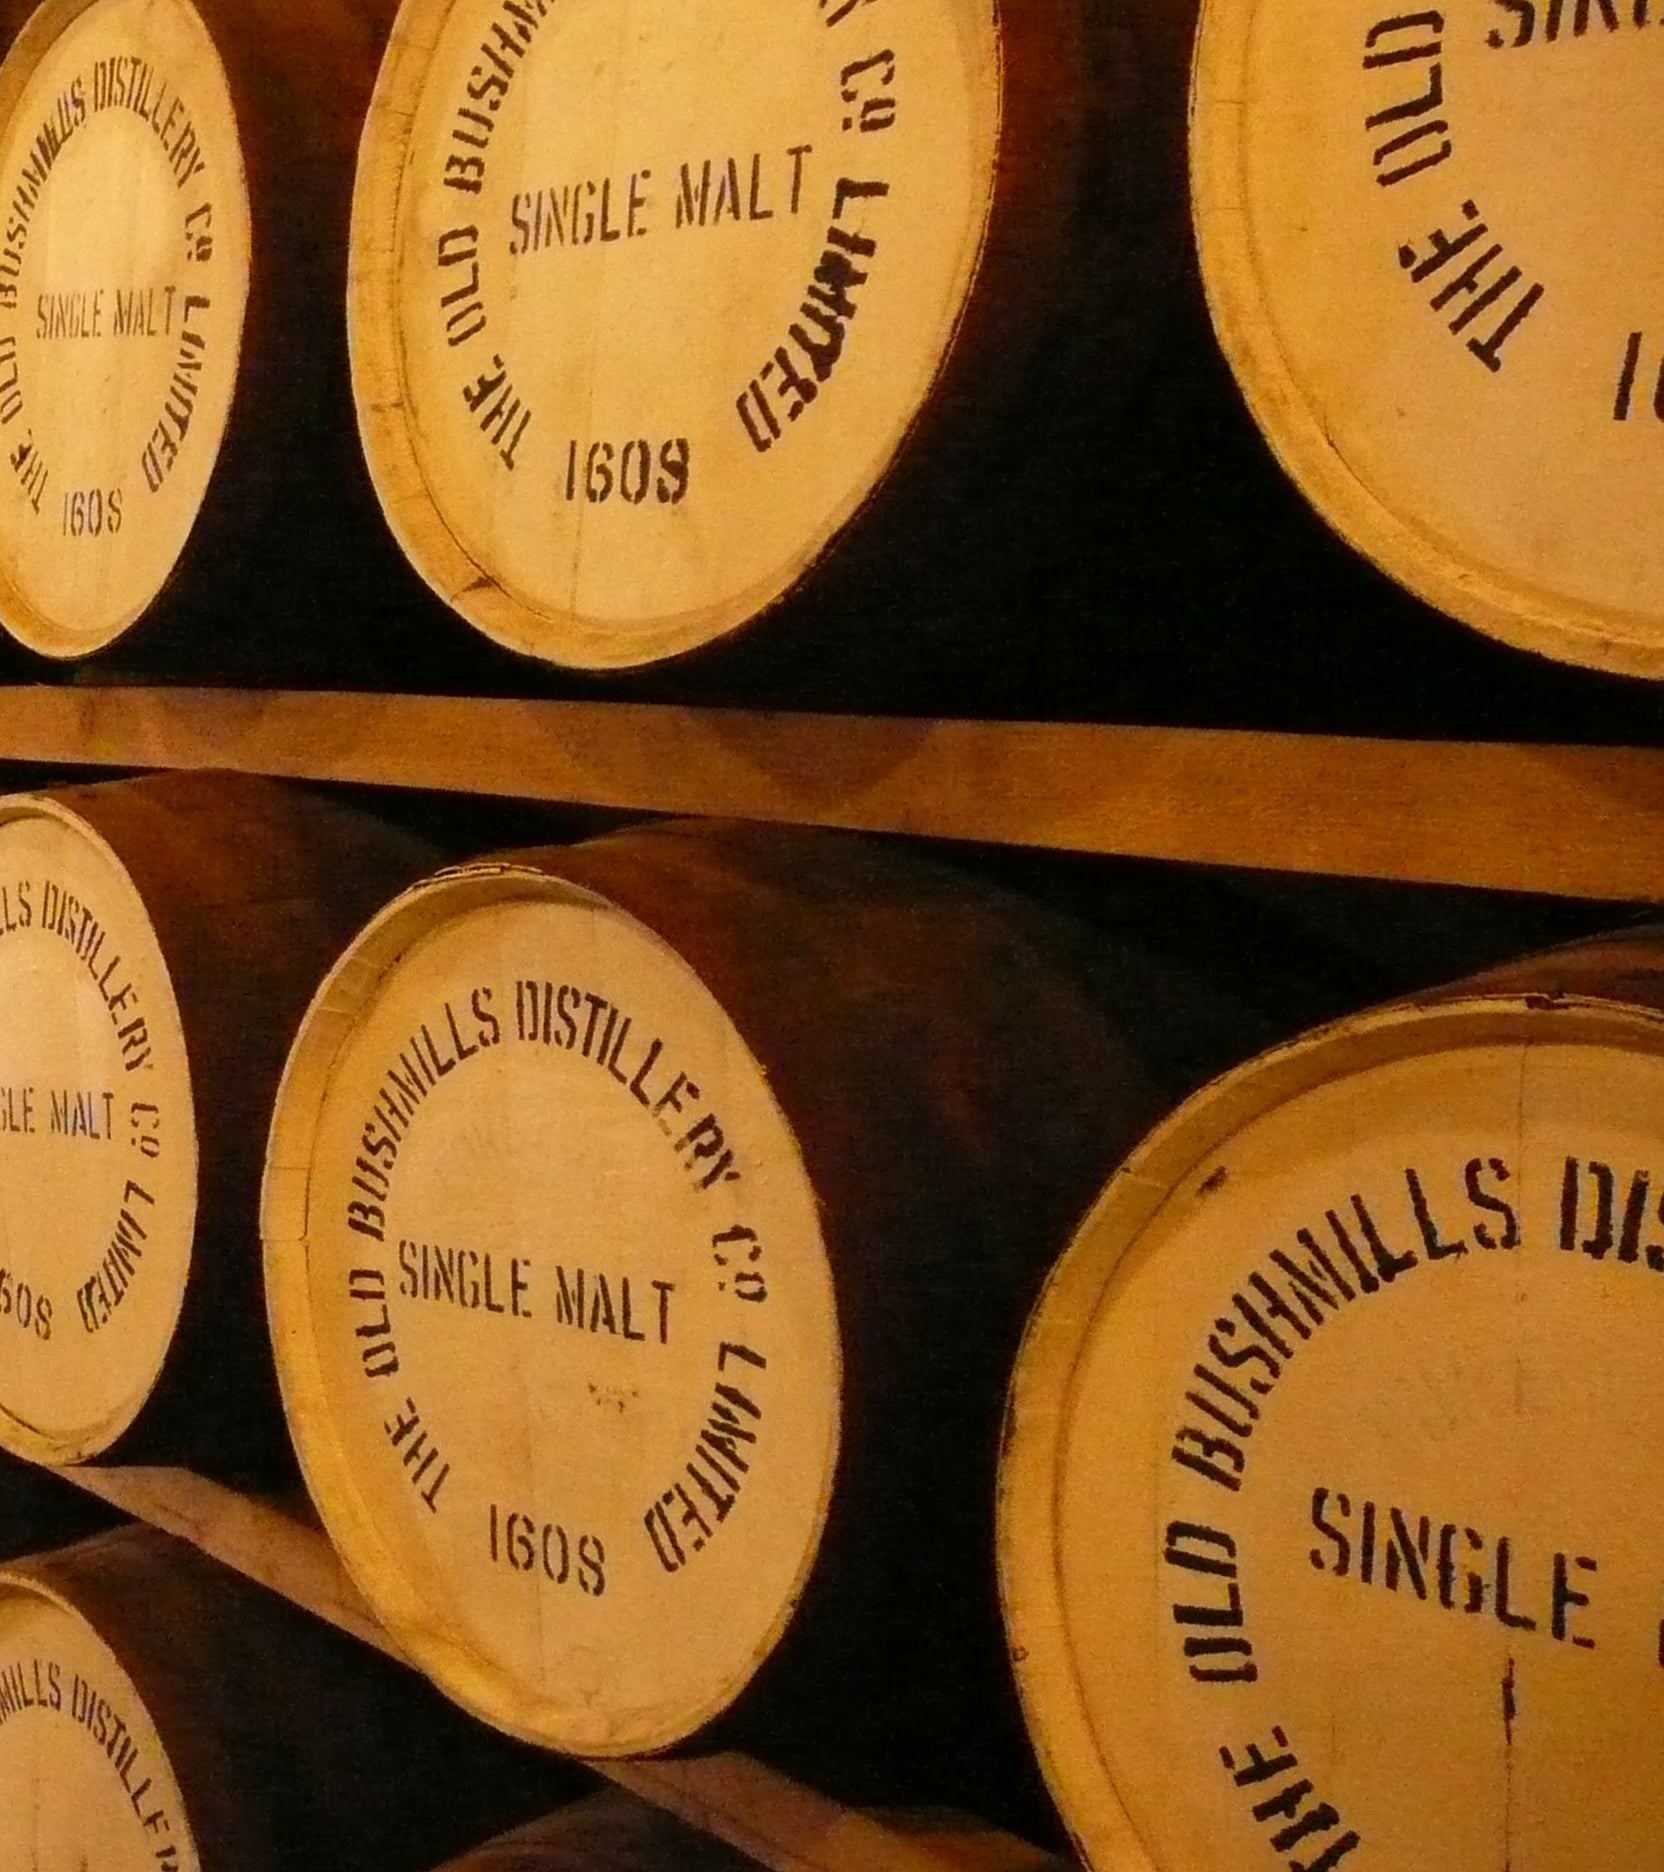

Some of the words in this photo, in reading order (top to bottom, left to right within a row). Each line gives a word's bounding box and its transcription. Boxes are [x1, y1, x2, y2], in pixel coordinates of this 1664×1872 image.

[1362, 10, 1452, 187] OLD
[509, 170, 651, 254] SINGLE
[676, 144, 812, 228] MALT
[36, 290, 103, 339] SINGLE
[113, 285, 176, 336] MALT
[438, 224, 486, 346] OLD
[1398, 200, 1544, 372] THE
[10, 429, 50, 515] THE
[462, 355, 531, 470] THE
[566, 437, 689, 503] 1608
[62, 487, 123, 537] 1608
[41, 880, 153, 1072] DISTILLERY
[50, 1090, 114, 1140] MALT
[348, 984, 500, 1243] BUSHMILLS
[515, 980, 741, 1193] DISTILLERY
[77, 1179, 154, 1334] LIMITED
[398, 1240, 531, 1319] SINGLE
[556, 1265, 675, 1344] MALT
[348, 1269, 400, 1378] OLD
[1172, 1157, 1520, 1491] BUSHMILLS
[383, 1397, 450, 1513] THE
[643, 1341, 768, 1572] LIMITED
[489, 1503, 605, 1596] 1608
[1164, 1520, 1258, 1682] OLD
[1310, 1488, 1597, 1649] SINGLE
